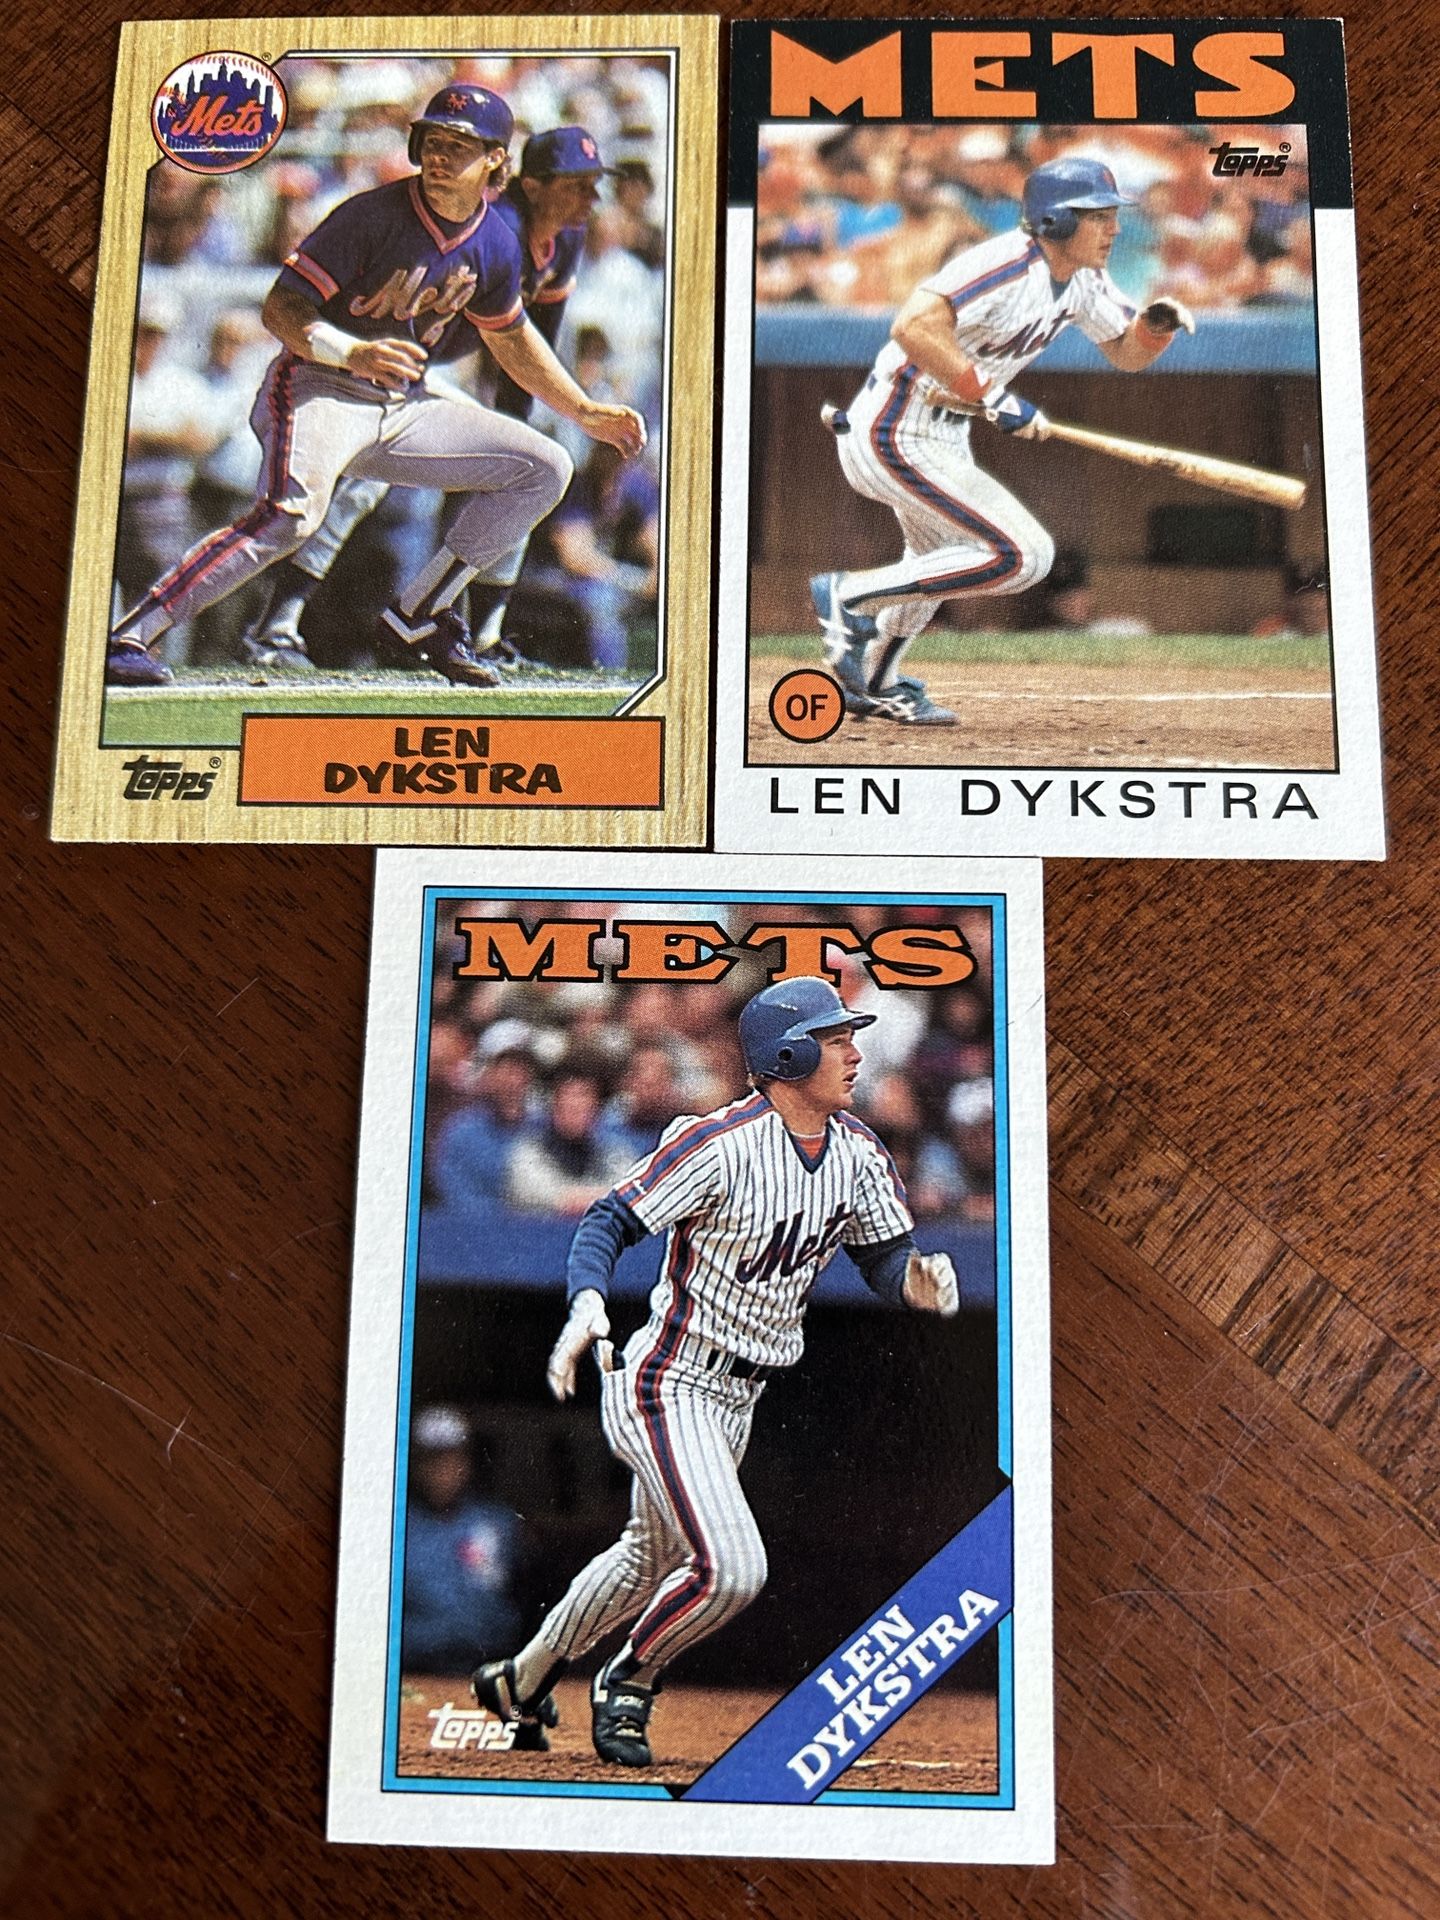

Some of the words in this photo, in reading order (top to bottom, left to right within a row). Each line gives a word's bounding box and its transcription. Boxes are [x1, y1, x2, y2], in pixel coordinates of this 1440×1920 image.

[770, 30, 1296, 118] METS
[170, 95, 265, 136] Mets
[976, 308, 1075, 360] Met
[785, 693, 829, 722] OF
[394, 726, 490, 758] LEN
[324, 761, 563, 795] DYKSTRA
[770, 777, 902, 815] LEN
[961, 778, 1320, 820] DYKSTRA
[453, 917, 978, 991] METS
[816, 1603, 917, 1706] LEN
[786, 1588, 1000, 1791] DYKSTRA
